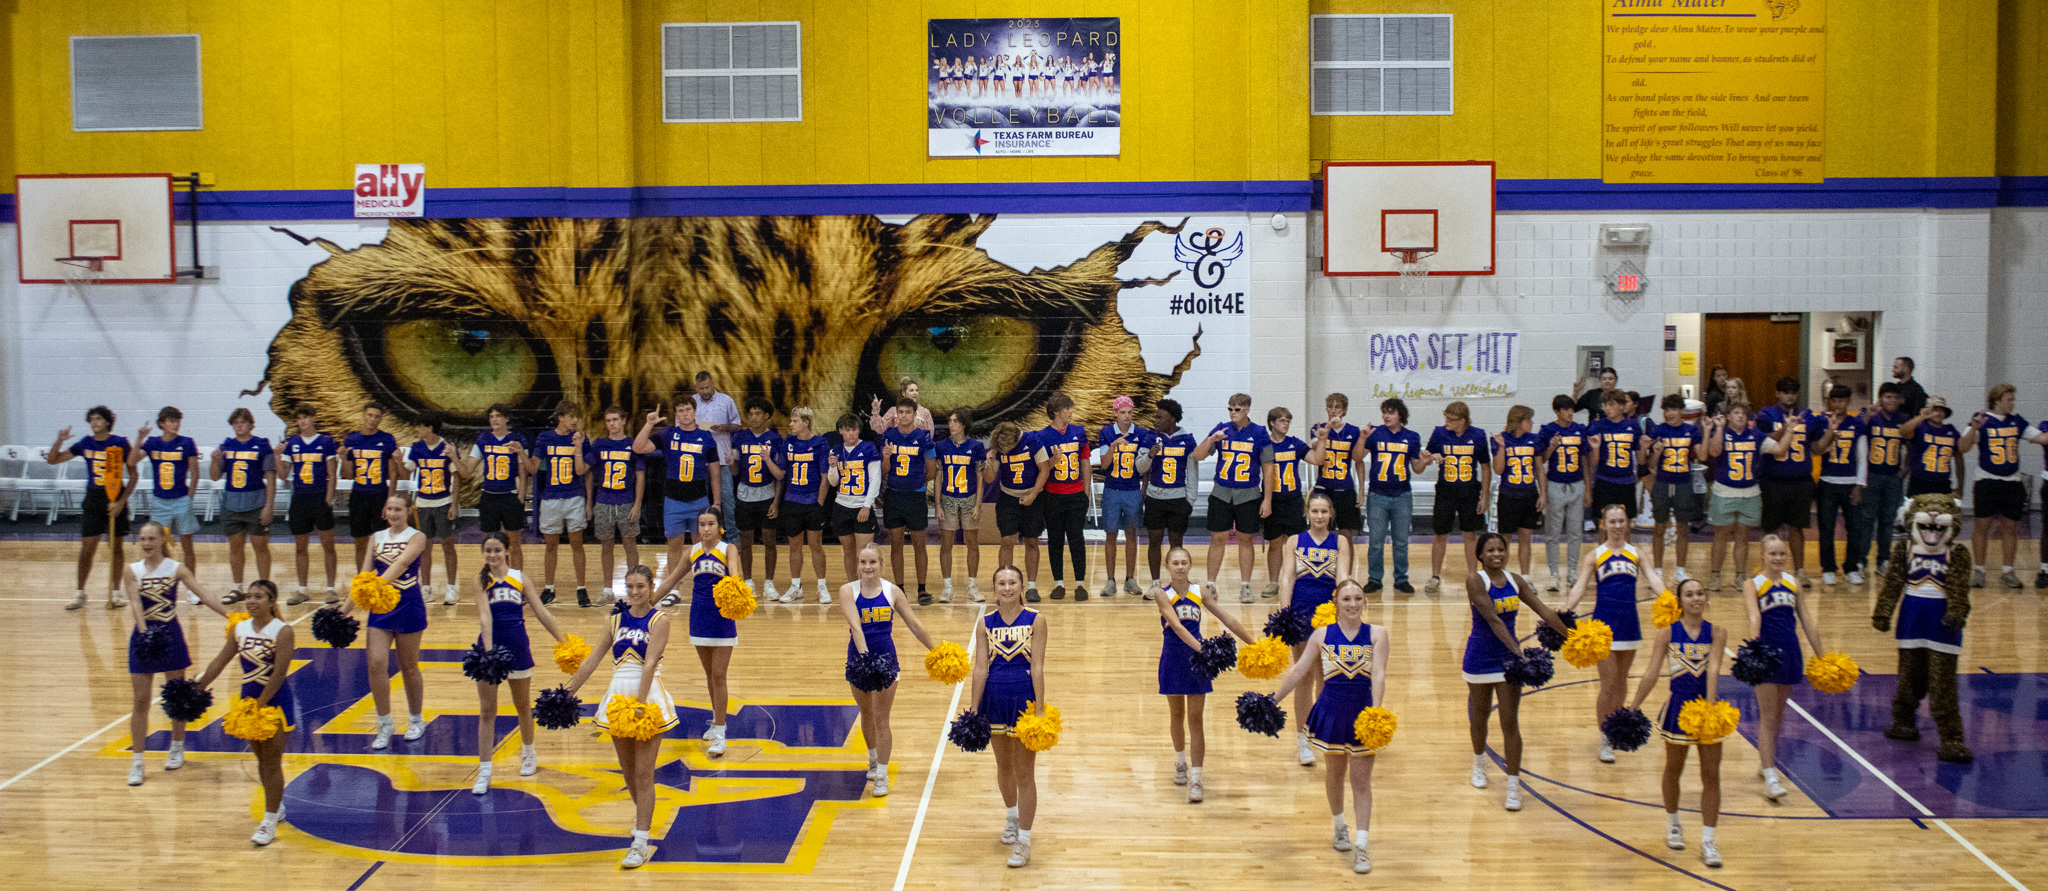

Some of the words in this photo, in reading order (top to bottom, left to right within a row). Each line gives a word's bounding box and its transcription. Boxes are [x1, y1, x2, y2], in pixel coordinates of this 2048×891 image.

[1009, 20, 1040, 28] 2025
[1606, 25, 1619, 33] We
[1622, 25, 1648, 35] pledge
[1650, 25, 1669, 33] dear
[1671, 25, 1693, 33] Alma
[1760, 27, 1778, 35] your
[1780, 25, 1807, 35] purple
[1809, 25, 1825, 33] and
[931, 33, 990, 47] LADY
[1008, 32, 1117, 47] LEOPARD
[1606, 55, 1617, 63] To
[1619, 55, 1646, 64] defend
[1648, 57, 1667, 65] your
[1694, 54, 1710, 62] and
[1712, 54, 1741, 63] banner,
[1754, 54, 1789, 62] students
[1792, 54, 1805, 62] did
[1807, 54, 1817, 65] of
[1606, 94, 1617, 102] As
[1635, 93, 1656, 102] band
[1658, 93, 1680, 104] plays
[1695, 94, 1708, 102] the
[1711, 93, 1727, 101] side
[1729, 93, 1749, 101] lines
[934, 107, 1115, 124] VOLLEYBALL
[1633, 108, 1657, 119] fights
[1672, 108, 1685, 116] the
[1686, 108, 1707, 119] field,
[1622, 125, 1645, 134] spirit
[1647, 123, 1657, 134] of
[1659, 125, 1677, 134] your
[1678, 123, 1719, 134] followers
[1721, 123, 1739, 131] Will
[1766, 123, 1776, 131] let
[1779, 126, 1794, 134] you
[995, 140, 1050, 148] INSURANCE
[1605, 139, 1614, 147] In
[1616, 139, 1627, 147] all
[1630, 139, 1639, 149] of
[1641, 139, 1660, 149] life's
[1662, 139, 1683, 149] great
[1686, 138, 1722, 149] struggles
[1726, 138, 1745, 146] That
[1747, 140, 1762, 149] any
[1765, 139, 1774, 149] of
[1786, 140, 1804, 149] may
[1606, 154, 1619, 162] We
[1621, 154, 1647, 164] pledge
[1650, 153, 1662, 161] the
[1687, 153, 1723, 161] devotion
[1727, 153, 1737, 161] To
[1739, 154, 1761, 163] bring
[1630, 170, 1654, 179] grace.
[1755, 168, 1778, 177] Class
[1780, 168, 1791, 177] of
[357, 165, 424, 207] ally
[1618, 275, 1638, 290] EXIT
[1170, 292, 1244, 315] #doit4E
[1477, 333, 1518, 374] HIT
[673, 432, 680, 440] C
[1557, 447, 1578, 472] 13
[1606, 442, 1630, 468] 15
[1663, 448, 1689, 473] 29
[1829, 440, 1852, 464] 17
[1870, 438, 1900, 465] 60
[1923, 445, 1953, 473] 42
[1988, 438, 2017, 464] 50
[92, 460, 106, 486] 5
[159, 462, 175, 490] 8
[231, 461, 248, 489] 6
[299, 461, 314, 484] 4
[355, 458, 382, 485] 24
[486, 455, 510, 480] 16
[550, 457, 573, 485] 10
[603, 462, 627, 490] 12
[679, 454, 694, 482] 0
[748, 455, 762, 483] 2
[791, 463, 808, 485] 11
[896, 455, 910, 476] 3
[1010, 463, 1024, 484] 7
[1054, 453, 1080, 481] 99
[1112, 452, 1134, 479] 19
[1162, 458, 1177, 484] 9
[1219, 452, 1251, 482] 72
[1322, 451, 1348, 480] 25
[1378, 453, 1407, 481] 74
[1444, 456, 1472, 482] 66
[1508, 457, 1534, 484] 33
[1728, 452, 1753, 481] 51
[839, 468, 865, 495] 23
[946, 465, 968, 493] 14
[1298, 547, 1337, 562] LEPS
[690, 560, 726, 577] LHS
[1595, 561, 1638, 582] LHS
[1759, 591, 1796, 611] LHS
[613, 627, 651, 646] Leps
[989, 625, 1034, 642] EOPARDS
[1328, 644, 1373, 661] LEPS
[1672, 643, 1708, 659] LEP
